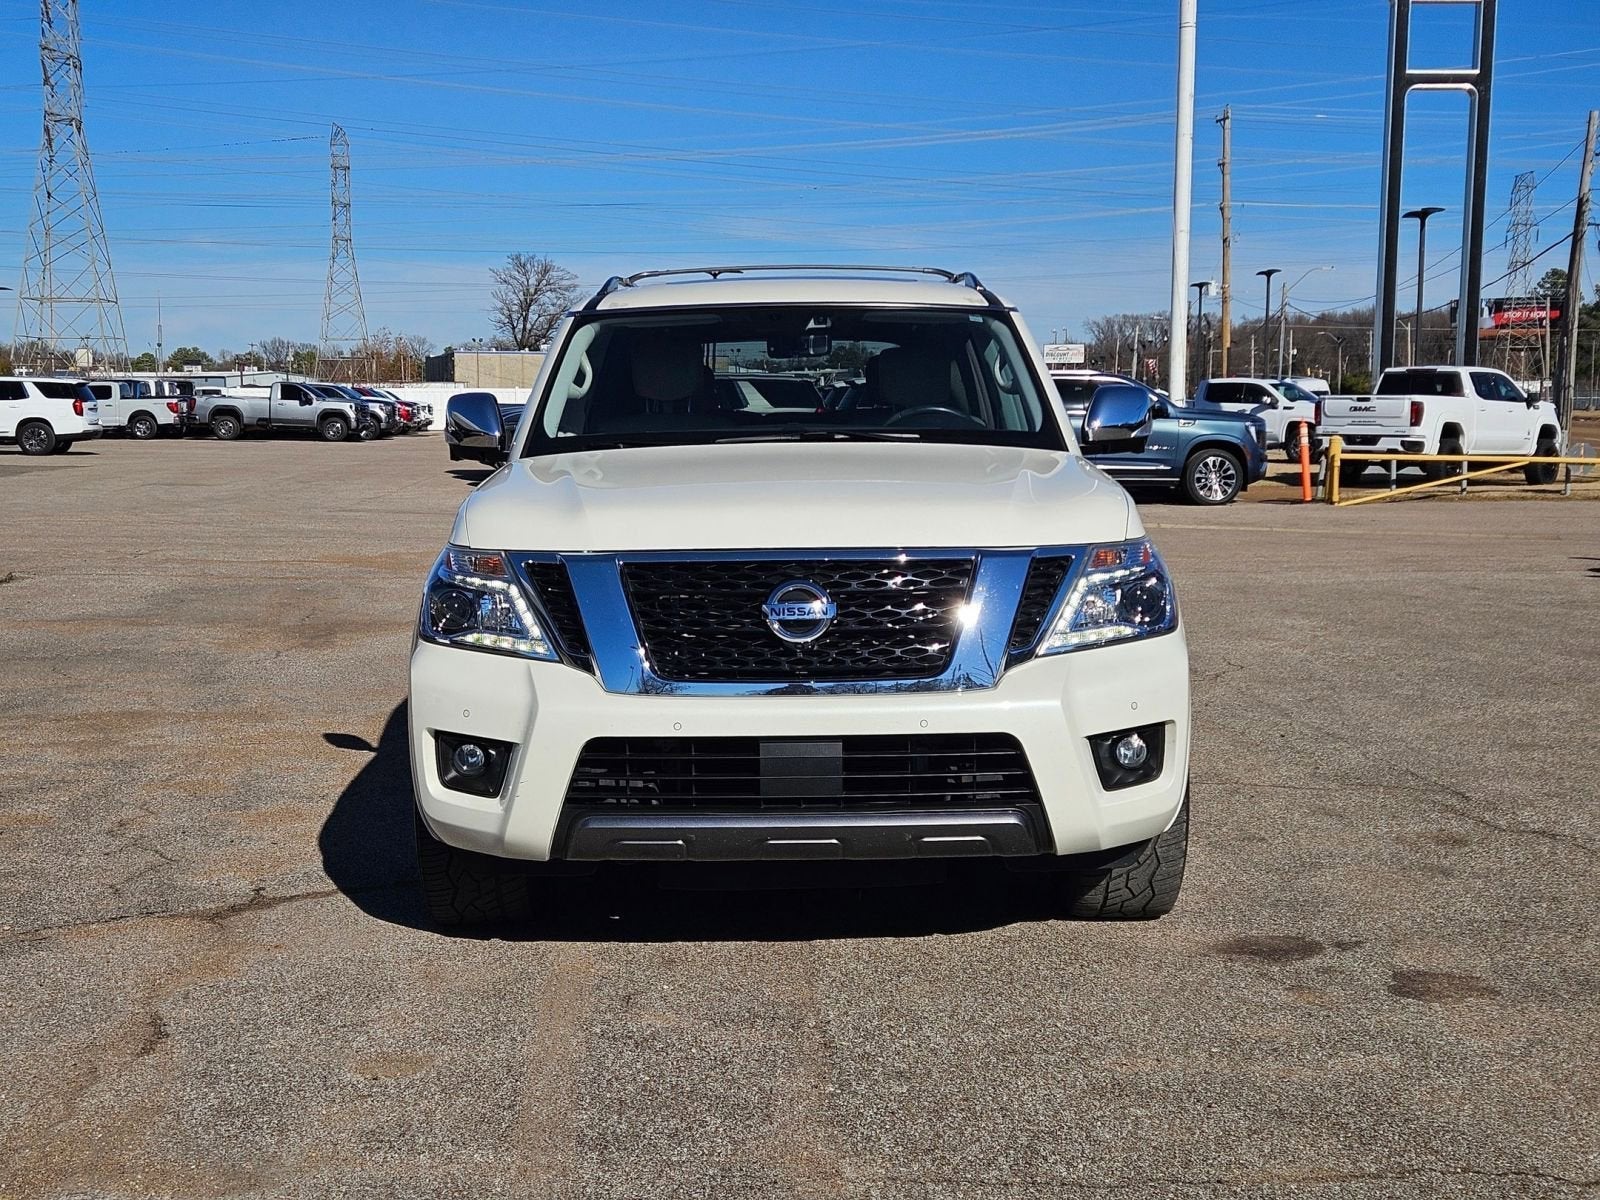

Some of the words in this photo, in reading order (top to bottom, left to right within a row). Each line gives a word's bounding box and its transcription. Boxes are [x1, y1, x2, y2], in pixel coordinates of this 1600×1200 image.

[1071, 350, 1084, 358] AUTO
[1349, 405, 1377, 413] GMC
[770, 607, 829, 617] NISSAN
